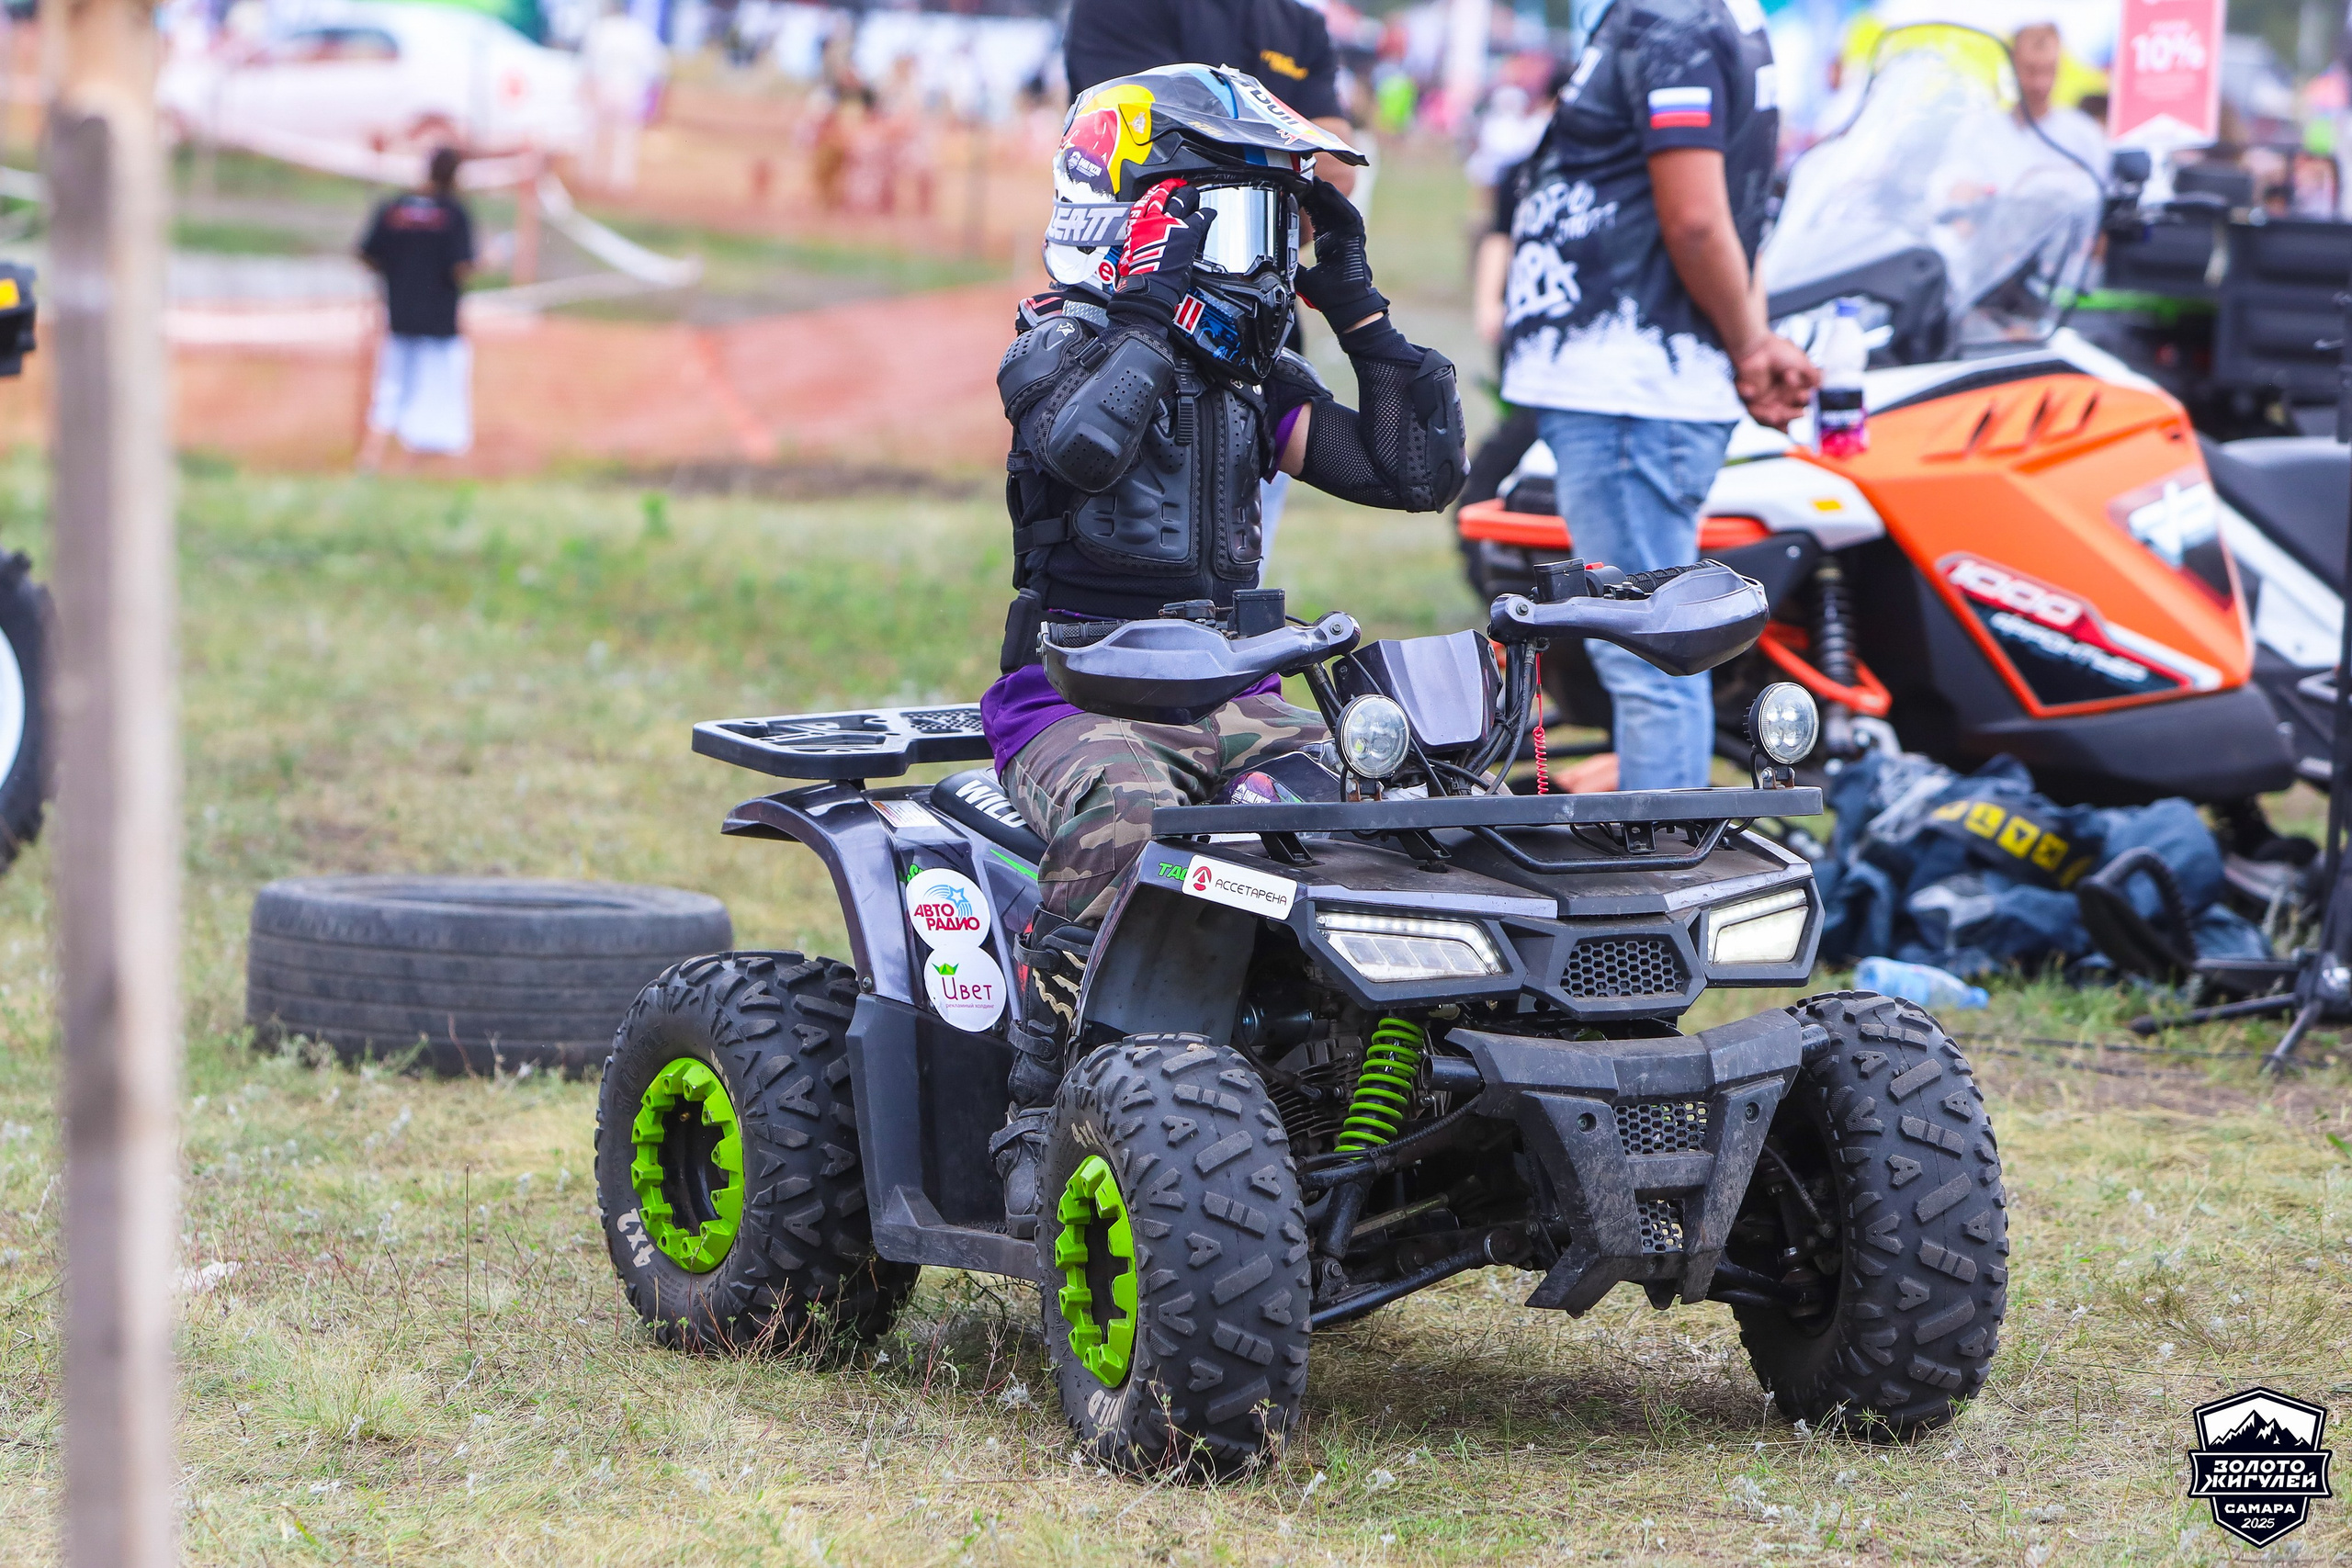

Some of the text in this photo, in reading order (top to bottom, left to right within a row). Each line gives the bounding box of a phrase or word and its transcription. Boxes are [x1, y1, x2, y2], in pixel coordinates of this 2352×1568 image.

[2132, 31, 2205, 73] 10%
[1950, 558, 2085, 627] 1000
[955, 779, 1028, 829] WILD
[913, 903, 955, 918] АВТО
[925, 916, 980, 931] РАДИО
[942, 976, 992, 1000] Цвет
